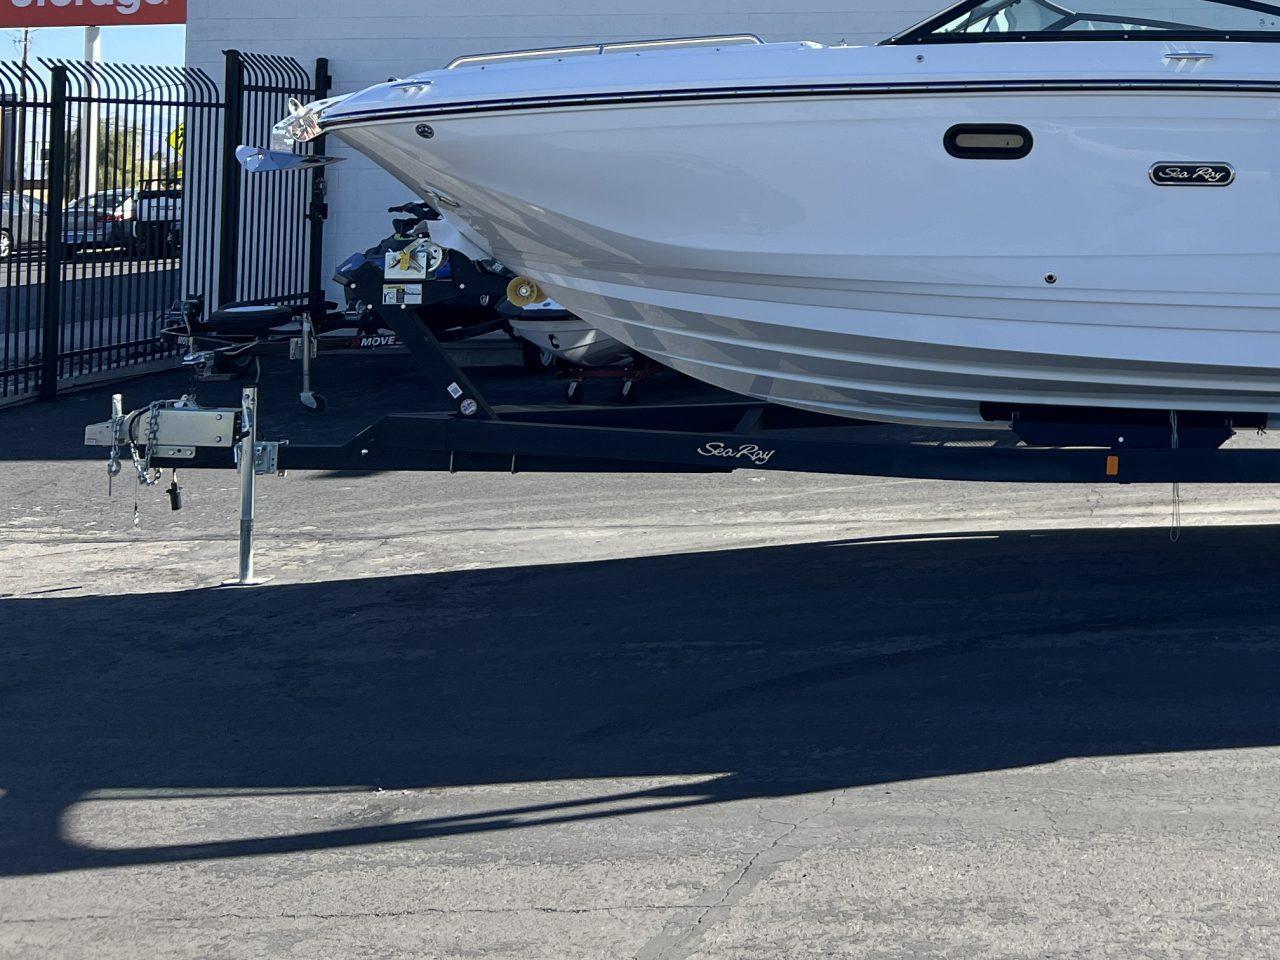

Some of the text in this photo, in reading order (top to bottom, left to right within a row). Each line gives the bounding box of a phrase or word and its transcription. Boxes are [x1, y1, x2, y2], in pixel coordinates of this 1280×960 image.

[1158, 166, 1225, 182] Sea Ray
[360, 336, 395, 347] MOVE
[697, 442, 775, 465] Sea Ray
